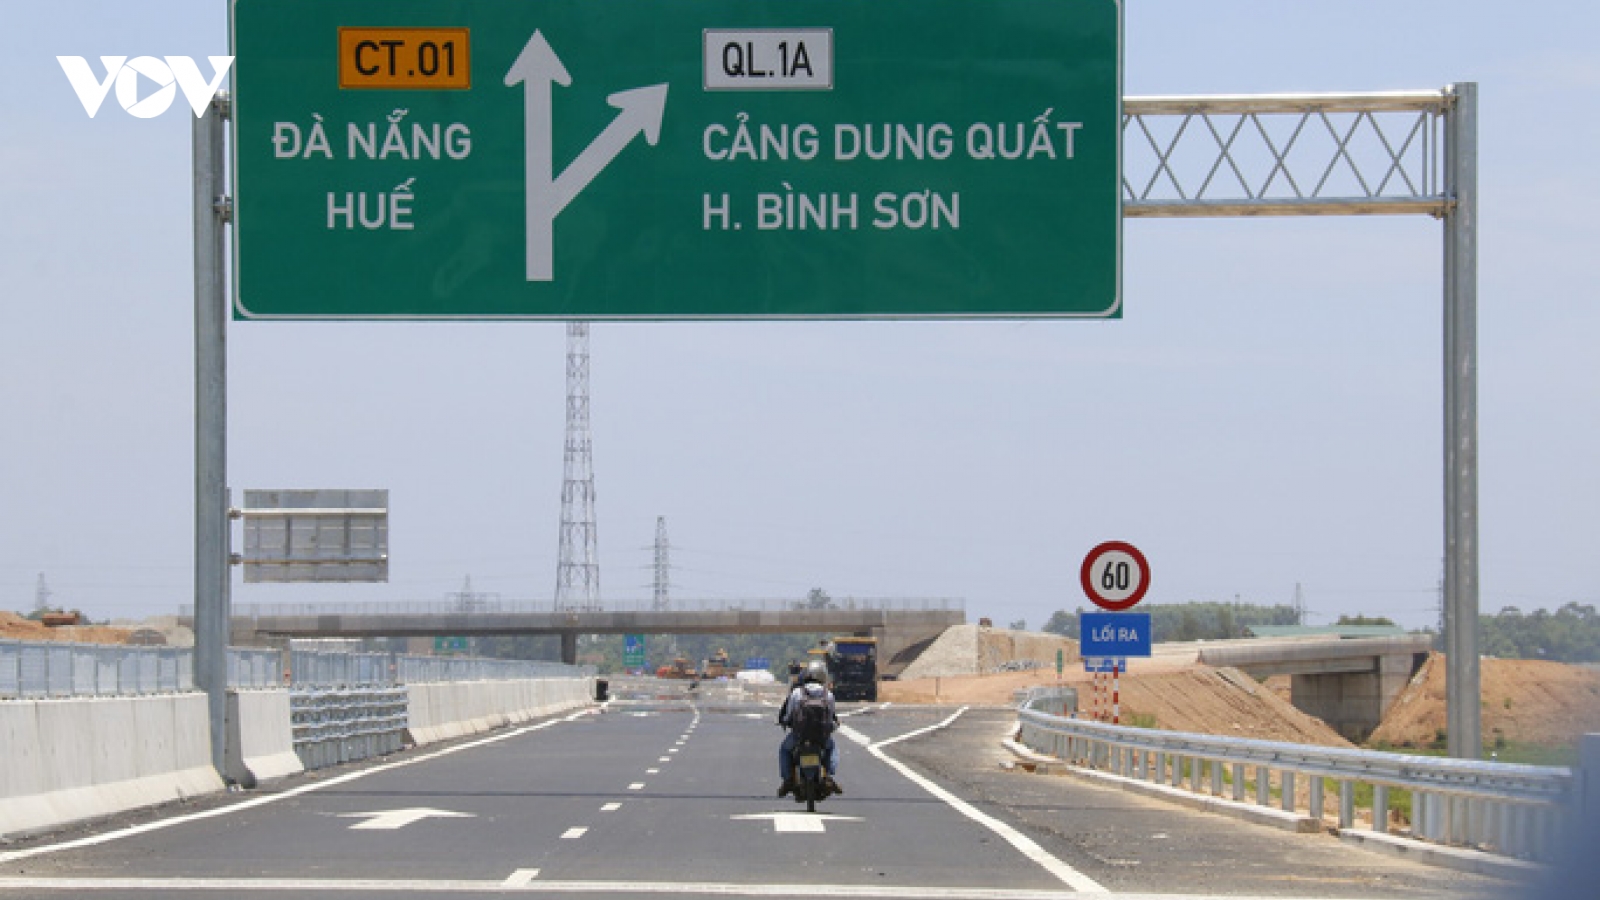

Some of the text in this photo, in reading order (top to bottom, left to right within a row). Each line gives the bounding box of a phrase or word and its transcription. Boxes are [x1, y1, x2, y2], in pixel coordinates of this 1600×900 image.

[354, 40, 456, 77] CT.01
[722, 41, 814, 78] QL.1A
[271, 108, 472, 160] ĐÀ NẴNG
[703, 107, 1083, 160] CẢNG DUNG QUẤT
[327, 177, 417, 230] HUẾ
[702, 181, 960, 230] H. BÌNH SƠN
[1101, 561, 1130, 590] 60
[1117, 627, 1139, 642] RA
